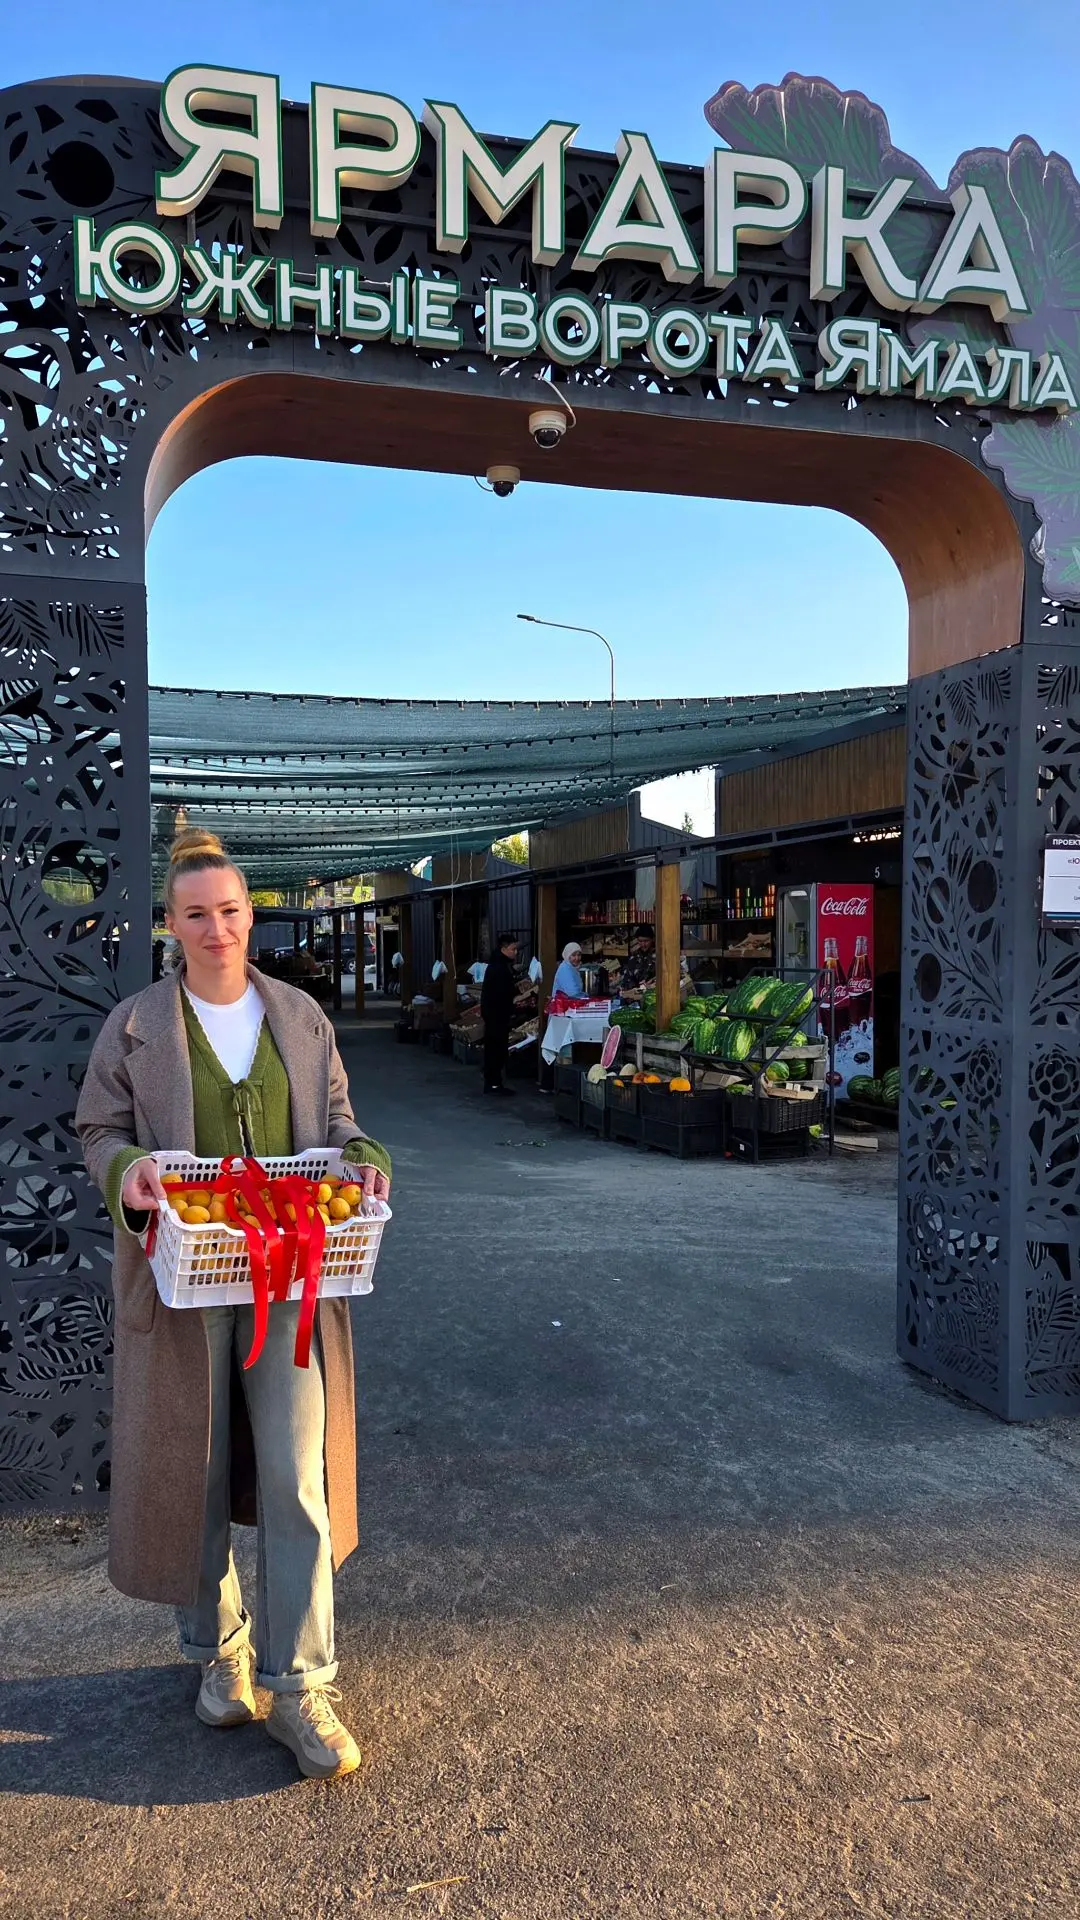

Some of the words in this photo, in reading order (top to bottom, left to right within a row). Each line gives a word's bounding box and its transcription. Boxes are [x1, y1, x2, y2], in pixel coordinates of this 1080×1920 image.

[155, 63, 1032, 323] ЯРМАРКА
[74, 215, 463, 350] ЮЖНЫЕ
[486, 285, 802, 384] ВОРОТА
[815, 317, 1078, 414] ЯМАЛА
[820, 897, 870, 916] Coca-Cola
[874, 866, 881, 879] 5
